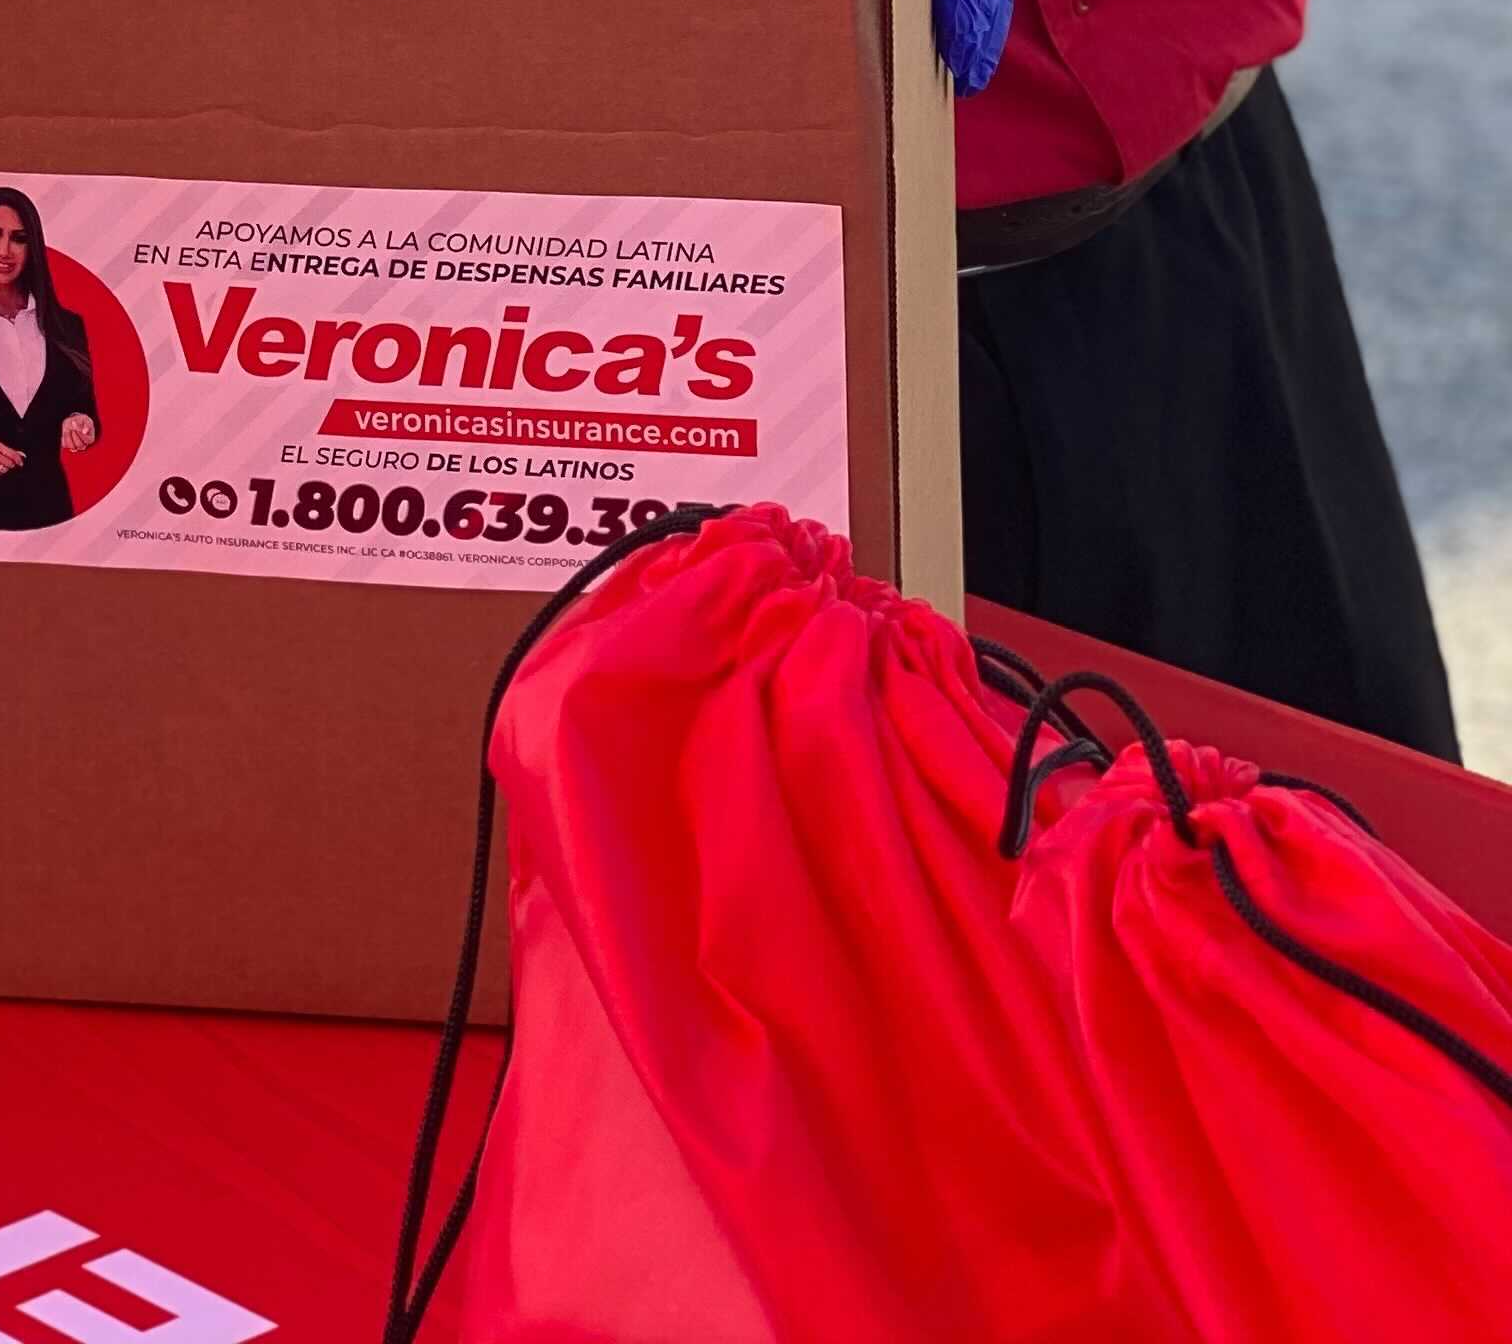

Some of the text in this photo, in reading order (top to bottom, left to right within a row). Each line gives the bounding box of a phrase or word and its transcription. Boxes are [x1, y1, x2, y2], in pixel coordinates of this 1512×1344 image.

[195, 220, 715, 264] APOYAMOS A LA COMUNIDAD LATINA
[133, 243, 786, 296] EN ESTA ENTREGA DE DESPENSAS FAMILIARES
[162, 280, 758, 401] Veronica's
[353, 407, 741, 450] veronicasinsurance.com
[279, 444, 636, 482] EL SEGURO DE LOS LATINOS
[246, 477, 746, 547] 1.800.639.39
[116, 529, 181, 543] VERONICA'S
[183, 533, 213, 546] AUTO
[215, 535, 279, 550] INSURANCE
[283, 541, 334, 554] SERVICES
[361, 547, 378, 558] LIC
[380, 548, 396, 558] CA
[458, 553, 525, 567] VERONICA'S
